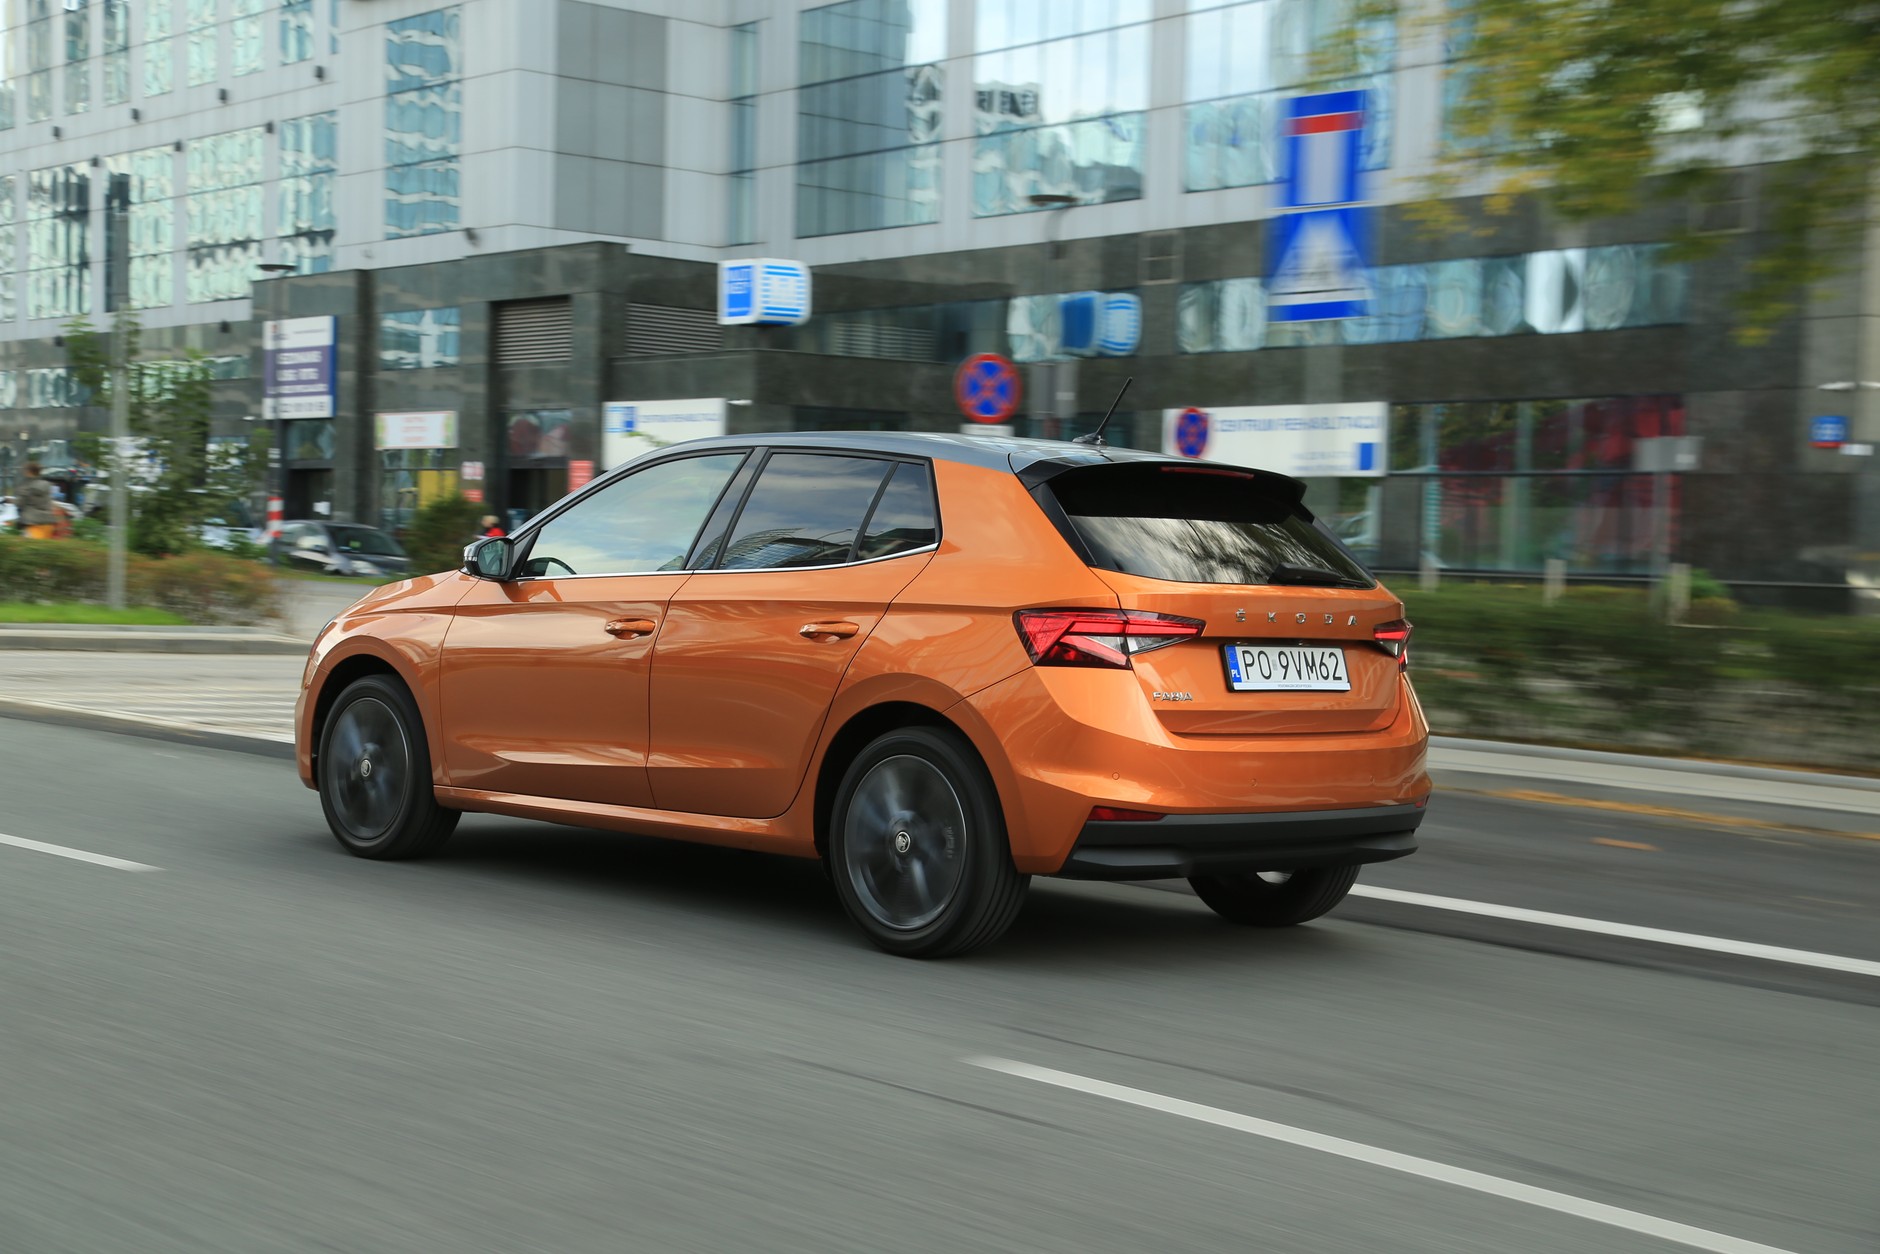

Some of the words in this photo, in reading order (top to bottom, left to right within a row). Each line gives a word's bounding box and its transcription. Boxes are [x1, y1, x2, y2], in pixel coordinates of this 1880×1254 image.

[1235, 608, 1358, 626] ŠKODA
[1241, 650, 1272, 680] PO
[1277, 650, 1343, 681] 9VM62
[1231, 669, 1241, 678] PL
[1152, 691, 1193, 701] FABIA
